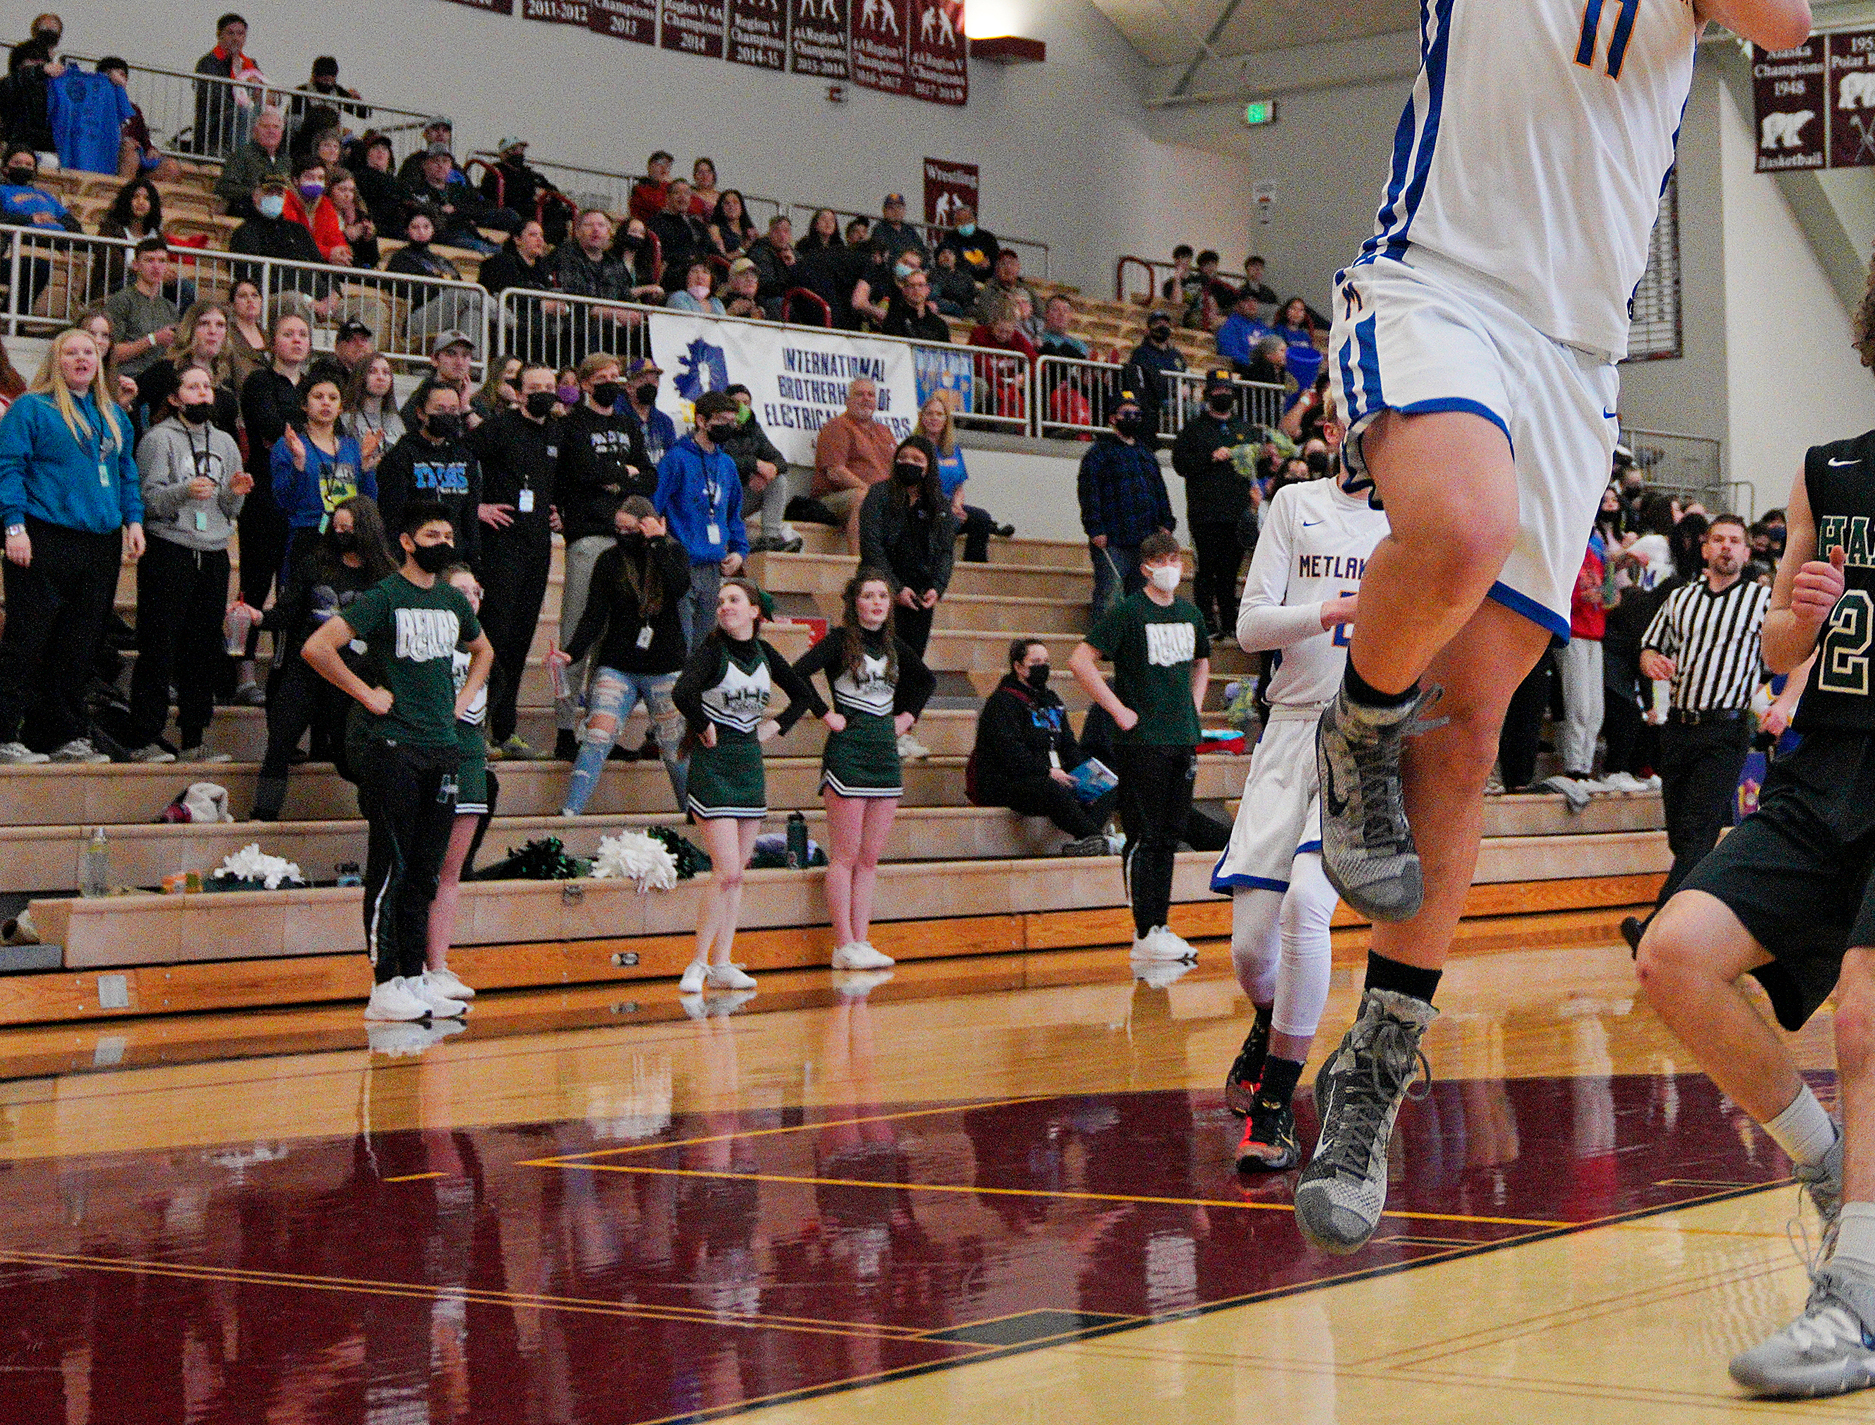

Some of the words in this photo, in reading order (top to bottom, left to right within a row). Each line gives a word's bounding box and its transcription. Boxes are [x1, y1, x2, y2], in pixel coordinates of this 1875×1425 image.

[1753, 61, 1825, 78] Champions
[1831, 53, 1865, 69] Polar
[1758, 151, 1823, 170] Basketball
[783, 347, 887, 383] INTERNATIONAL
[777, 374, 848, 406] BROTHERH
[877, 388, 892, 412] OF
